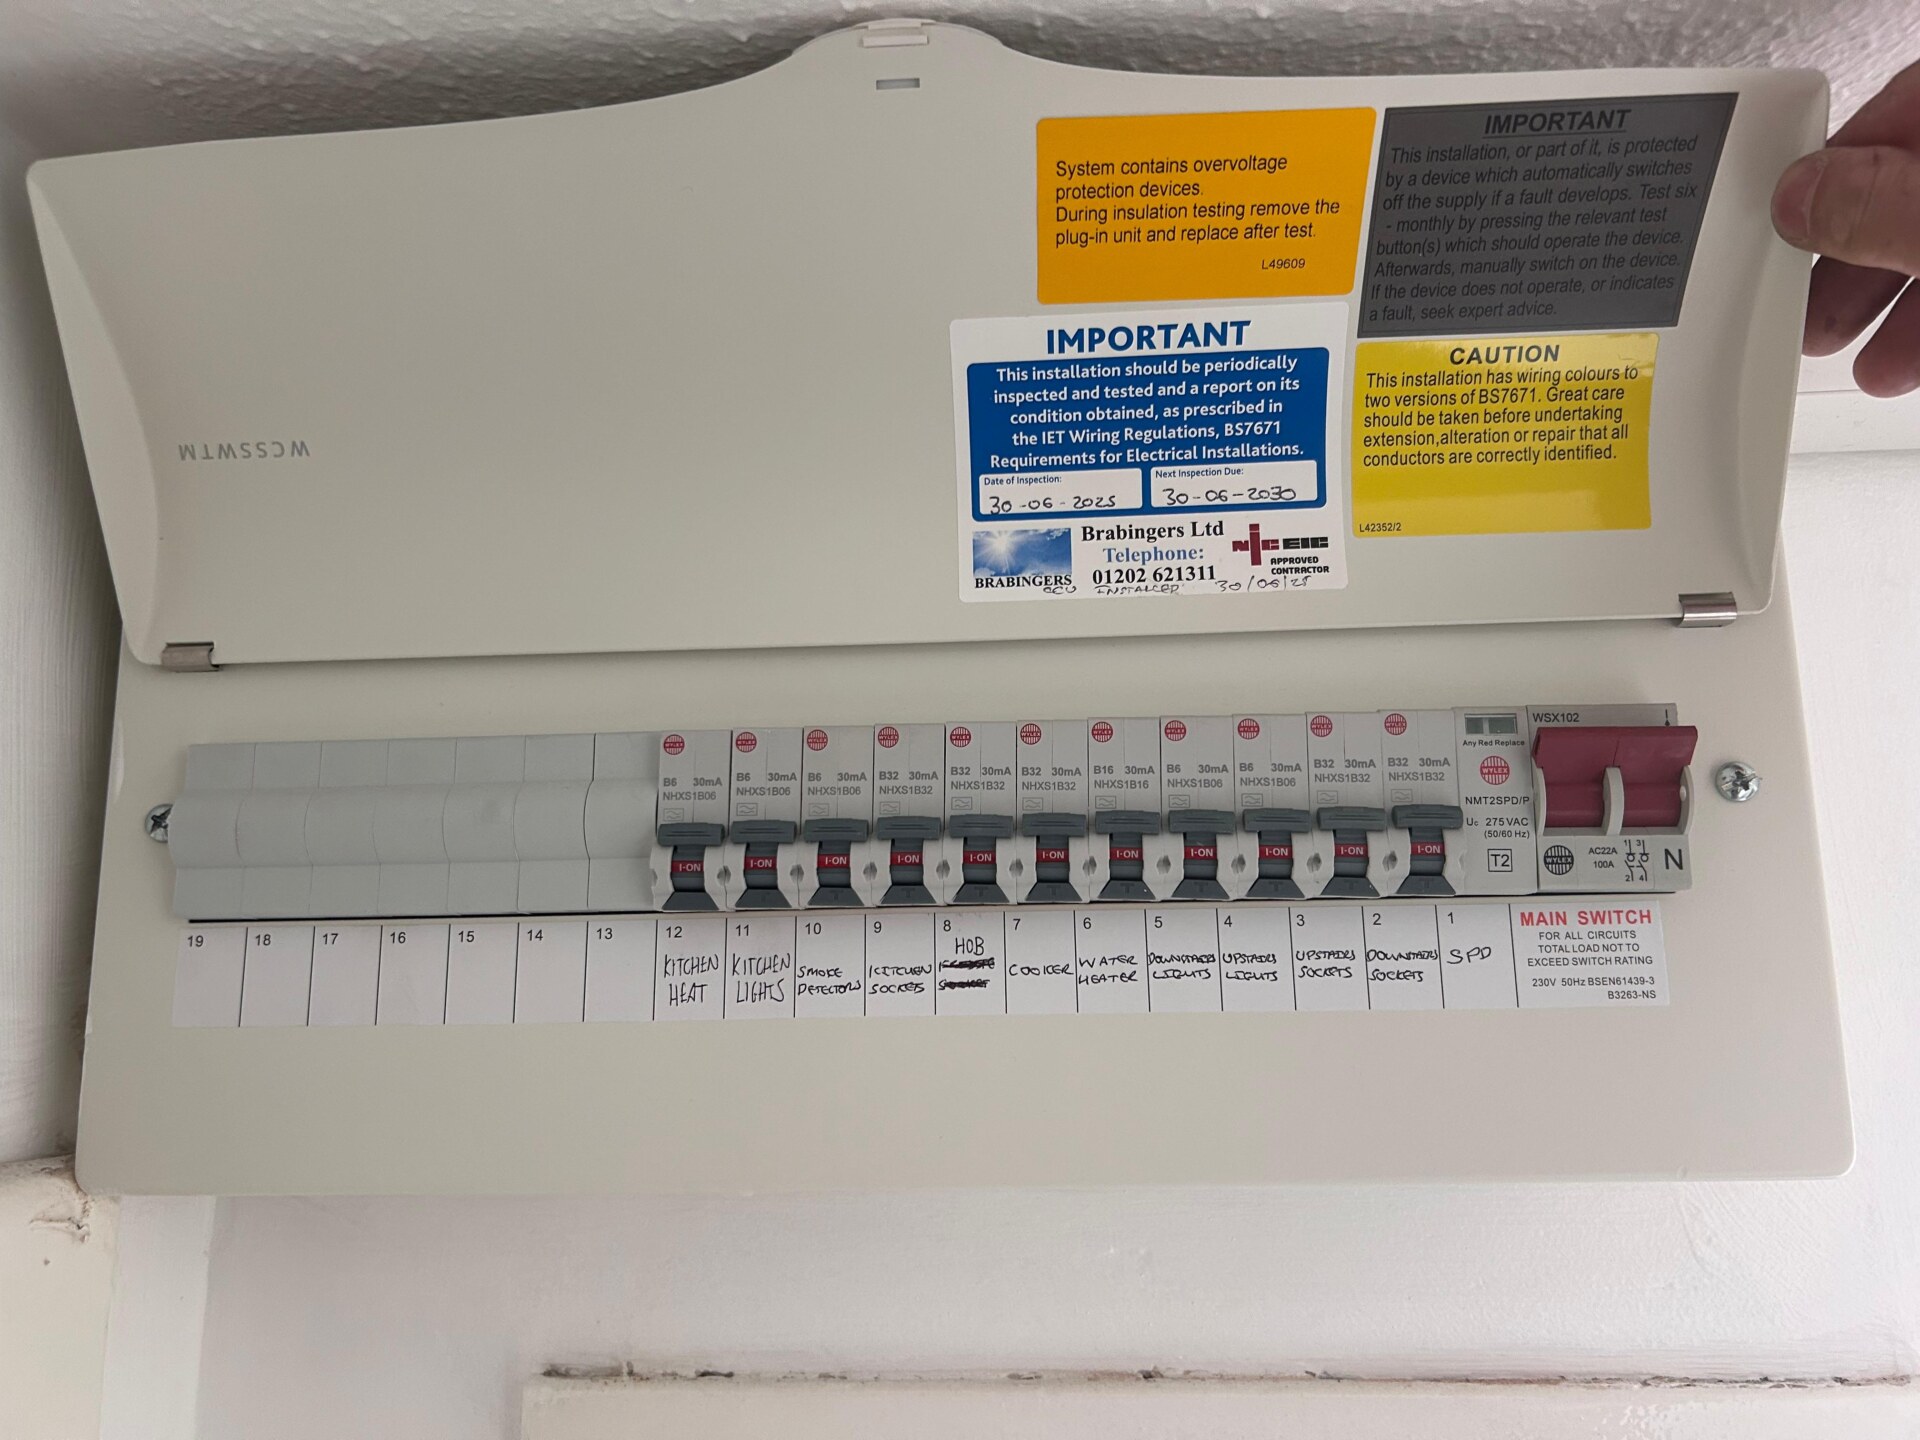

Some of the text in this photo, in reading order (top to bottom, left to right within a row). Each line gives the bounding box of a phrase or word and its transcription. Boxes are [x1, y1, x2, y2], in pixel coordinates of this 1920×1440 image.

[1485, 109, 1631, 134] IMPORTANT
[1391, 148, 1421, 164] This
[1426, 144, 1510, 163] installation,
[1516, 145, 1532, 158] or
[1536, 142, 1566, 161] part
[1571, 140, 1587, 157] of
[1608, 139, 1620, 154] is
[1624, 135, 1698, 158] protected
[1056, 156, 1287, 180] System contains overvoltage
[1056, 181, 1203, 202] protection devices.
[1056, 199, 1339, 224] During insulation testing remove the
[1056, 224, 1316, 248] plug-in unit and replace after test.
[1262, 259, 1305, 270] L49609
[1374, 252, 1680, 277] Afterwards, manually switch on the device.
[1047, 321, 1251, 355] IMPORTANT
[1450, 345, 1560, 365] CAUTION
[997, 355, 1297, 382] This installation should be periodically
[1367, 366, 1638, 388] This installation has wiring colours to
[1365, 387, 1624, 408] two versions of BS7671. Great care
[1012, 421, 1280, 446] the IET Wiring Regulations, BS7671
[991, 442, 1304, 471] Requirements for Electrical Installations.
[1363, 445, 1617, 467] conductors are correctly identified.
[1156, 467, 1244, 479] Next Inspection Due:
[984, 475, 1062, 486] Date of Inspection:
[1082, 521, 1224, 544] Brabingers Ltd
[1359, 523, 1401, 532] L42352/2
[1103, 547, 1204, 566] Telephone:
[1271, 556, 1319, 565] APPROVED
[1092, 565, 1215, 585] 01202 621311
[1271, 565, 1329, 575] CONTRACTOR
[975, 575, 1072, 589] BRABINGERS
[1533, 713, 1579, 723] WSX102
[1494, 739, 1525, 747] Replace
[1388, 758, 1450, 767] B32 30mA
[879, 771, 938, 780] B32 30mA
[1021, 767, 1081, 776] B32 30mA
[1093, 766, 1155, 774] B16 30mA
[663, 777, 722, 786] B6 30mA
[737, 773, 797, 781] B6 30mA
[1388, 772, 1445, 781] NHXS1B32
[879, 785, 932, 794] NHXS1B32
[1021, 781, 1076, 790] NHXS1B32
[1094, 780, 1149, 789] NHXS1B16
[663, 791, 716, 800] NHXS1B06
[736, 787, 790, 796] NHXS1B06
[1465, 796, 1529, 805] NMT2SPD/P
[1486, 818, 1528, 826] 275 VAC
[1484, 830, 1530, 839] (50/60 Hz)
[1491, 854, 1510, 867] T2
[1594, 861, 1614, 869] 100A
[1665, 849, 1683, 870] N
[1297, 915, 1305, 926] 3
[1448, 912, 1454, 924] 1
[1520, 910, 1652, 926] MAIN SWITCH
[805, 923, 821, 934] 10
[943, 920, 951, 932] 8
[390, 932, 406, 944] 16
[527, 929, 543, 942] 14
[666, 927, 682, 938] 12
[1539, 930, 1636, 941] FOR ALL CIRCUITS
[187, 935, 203, 948] 19
[955, 937, 984, 956] HOB
[1538, 943, 1639, 953] TOTAL LOAD NOT TO
[1079, 955, 1138, 967] WATER
[1296, 950, 1355, 961] UPSTAIRS
[1447, 947, 1491, 964] SPD
[1528, 956, 1653, 966] EXCEED SWITCH RATING
[664, 953, 718, 977] KITCHEN
[732, 953, 790, 976] KITCHEN
[1009, 964, 1074, 976] COOKER
[1079, 971, 1138, 985] HEATER
[1298, 967, 1352, 979] SOCKETS
[1532, 977, 1654, 986] 230V 50Hz BSEN61439-3
[669, 983, 708, 1006] HEAT
[737, 979, 784, 1003] LIGHTS
[1608, 990, 1656, 999] B3263-NS
